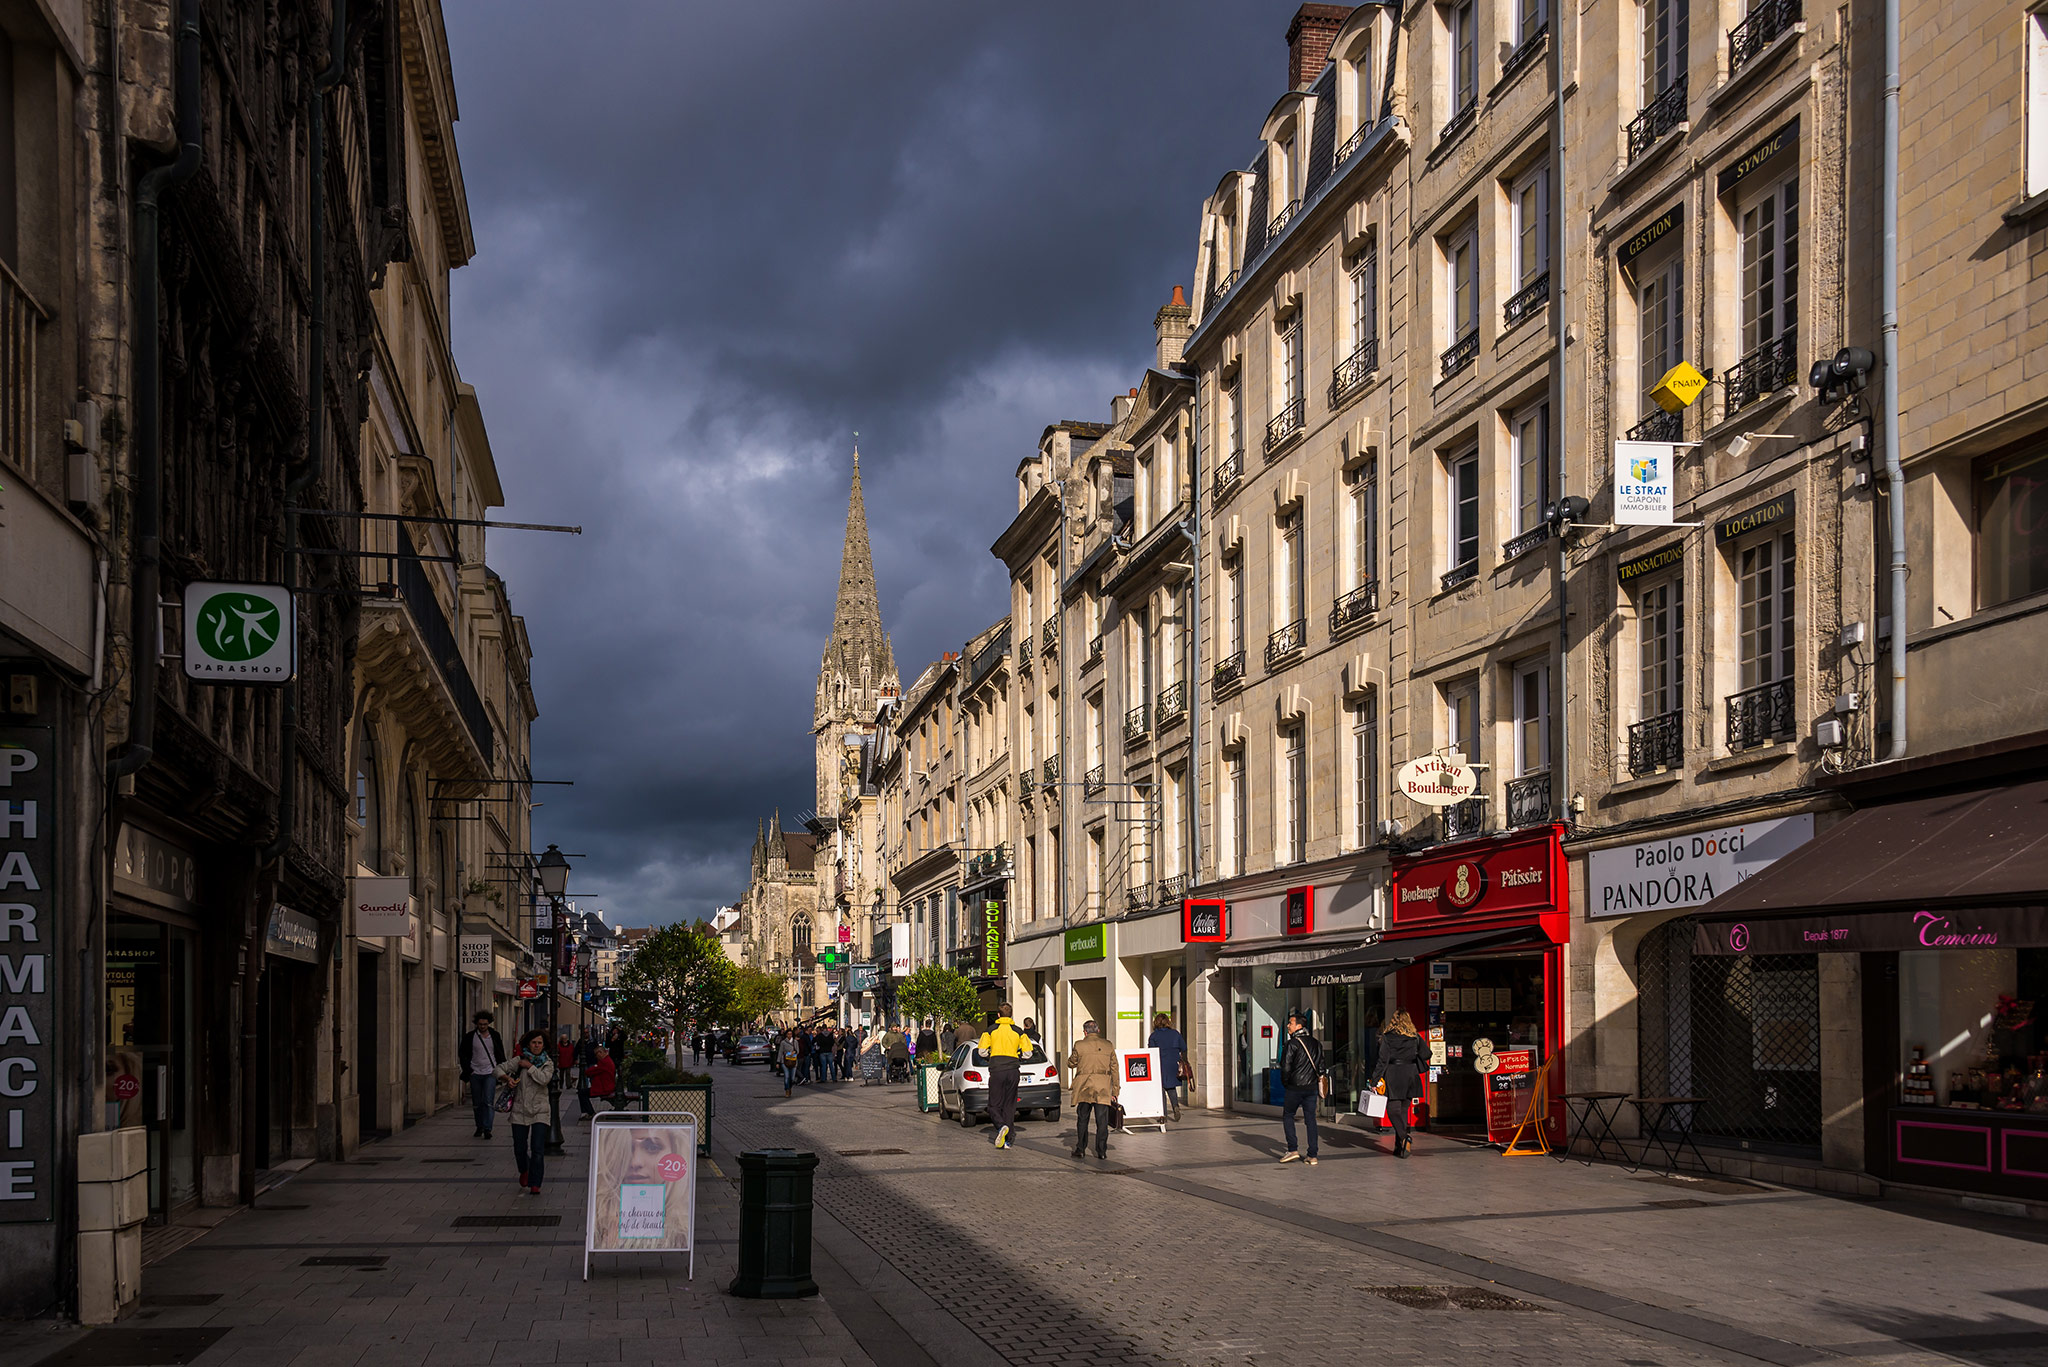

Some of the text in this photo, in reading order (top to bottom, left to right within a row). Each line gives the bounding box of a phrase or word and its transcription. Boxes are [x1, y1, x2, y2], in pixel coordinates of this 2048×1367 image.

[1737, 135, 1782, 178] SYNDIC
[1629, 215, 1671, 255] GESTION
[1673, 379, 1700, 388] FNAIM
[1620, 486, 1667, 495] LE STRAT
[1725, 501, 1784, 537] LOCATION
[1619, 545, 1683, 580] TRANSACTIONS
[195, 664, 282, 673] PARASHOP
[1415, 759, 1462, 777] Artisan
[1408, 781, 1469, 796] Boulanger
[1636, 828, 1744, 868] Paolo Docci
[114, 838, 178, 889] SHOP
[1401, 885, 1440, 903] Boulanger
[1603, 872, 1715, 911] PANDORA
[358, 902, 407, 916] eurodif
[985, 901, 1000, 976] BOULANGERIE
[1193, 926, 1216, 934] LAURE
[1804, 929, 1848, 942] Depuis 1877
[0, 748, 45, 1200] PHARMACIE
